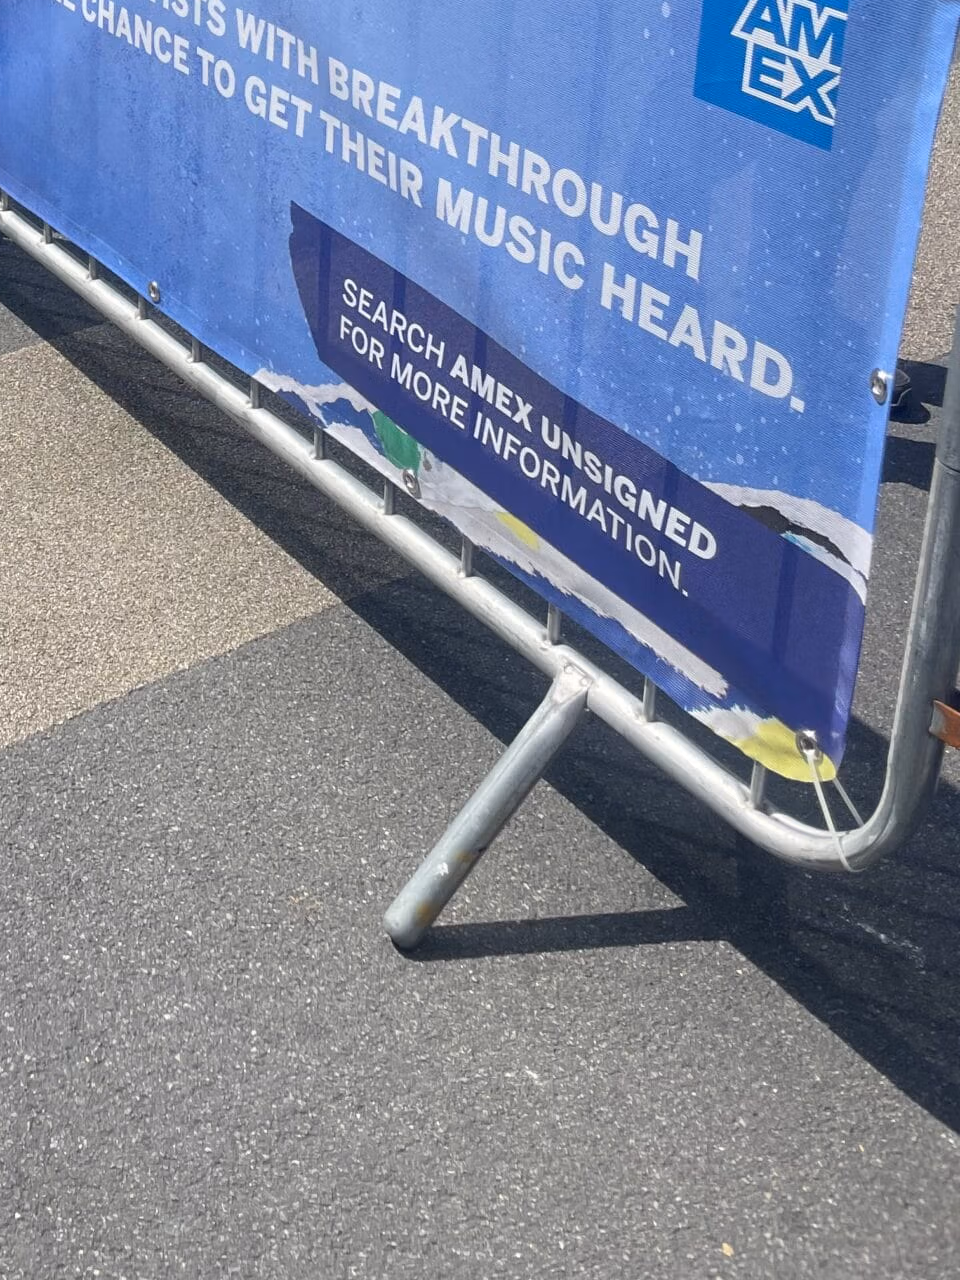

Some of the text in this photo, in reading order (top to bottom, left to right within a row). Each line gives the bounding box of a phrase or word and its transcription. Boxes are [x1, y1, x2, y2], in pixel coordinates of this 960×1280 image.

[195, 45, 236, 100] TO
[244, 74, 313, 139] GET
[319, 109, 424, 209] THEIR
[435, 177, 586, 291] MUSIC
[600, 261, 806, 414] HEARD.
[235, 7, 319, 86] WITH
[327, 56, 704, 281] BREAKTHROUGH
[339, 314, 690, 598] FOR MORE INFORMATION.
[341, 277, 718, 561] SEARCH AMEX UNSIGNED
